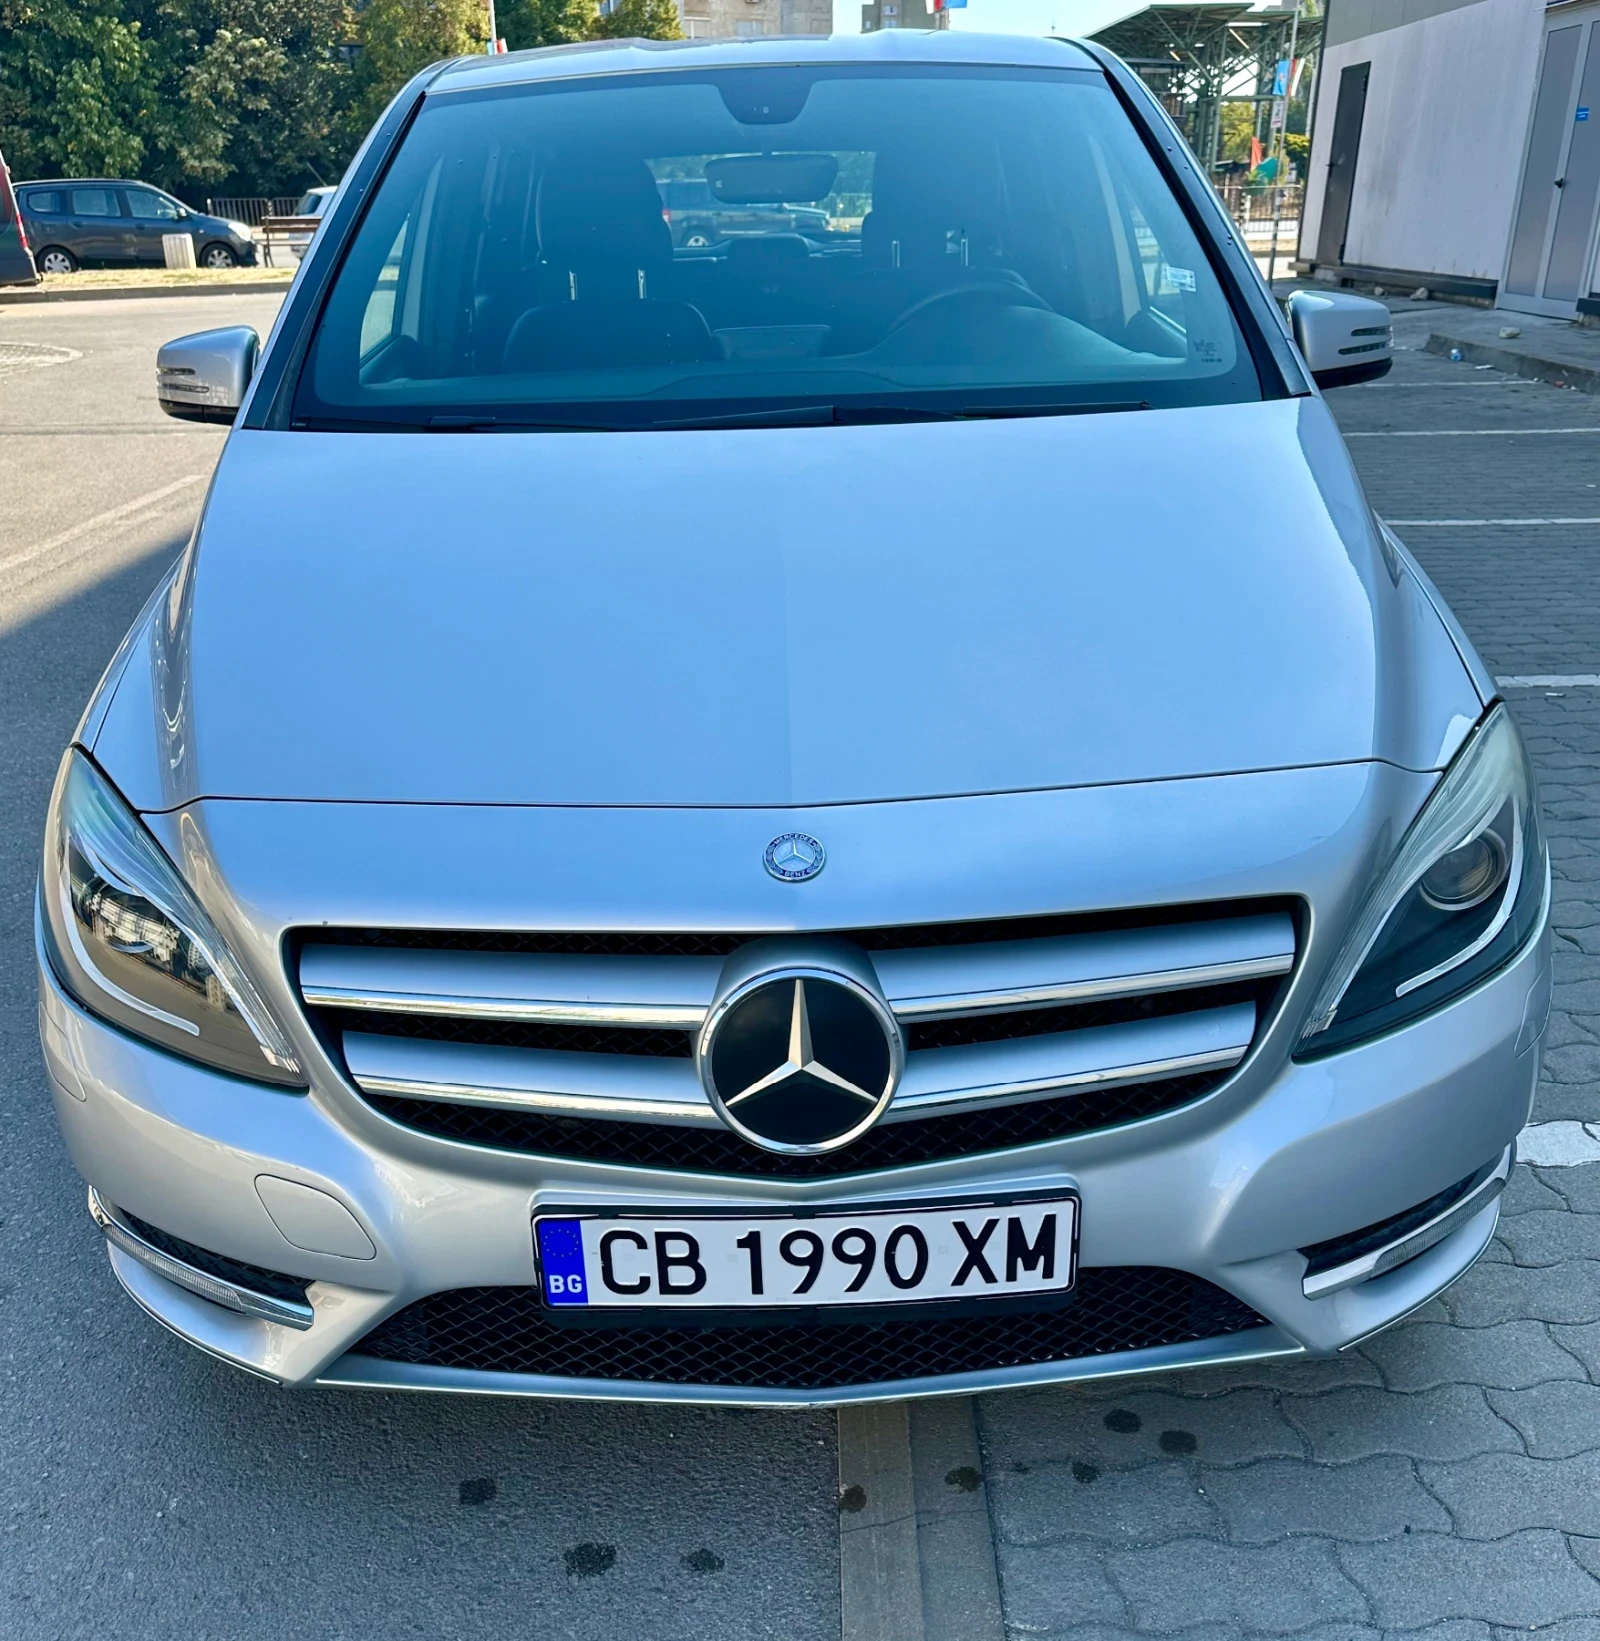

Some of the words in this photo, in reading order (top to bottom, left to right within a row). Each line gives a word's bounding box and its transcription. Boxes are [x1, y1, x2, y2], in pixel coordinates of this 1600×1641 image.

[774, 833, 815, 844] MERCEDES
[784, 870, 807, 878] BENZ
[600, 1229, 707, 1295] CB
[736, 1224, 929, 1294] 1990
[951, 1213, 1057, 1287] XM
[549, 1274, 583, 1294] BG
